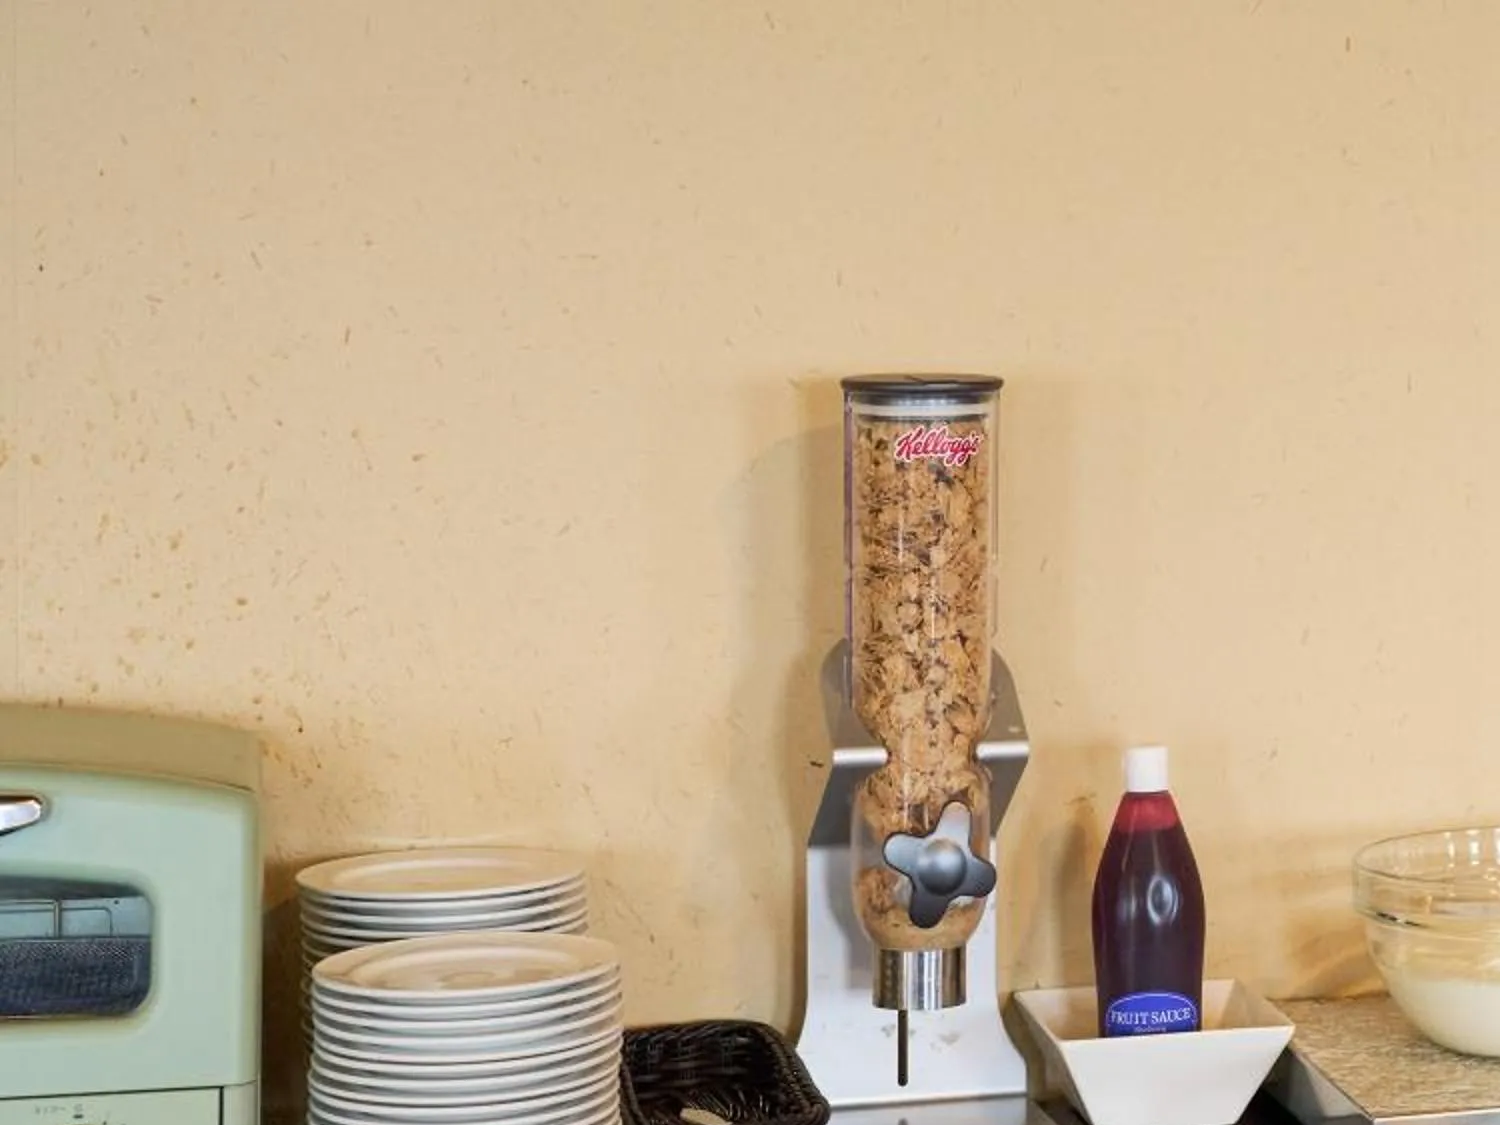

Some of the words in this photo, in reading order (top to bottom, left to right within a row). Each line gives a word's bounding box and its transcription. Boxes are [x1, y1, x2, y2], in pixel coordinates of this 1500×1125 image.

[895, 425, 983, 467] Kellogg's
[1111, 1010, 1149, 1025] FRUIT
[1151, 1007, 1191, 1025] SAUCE
